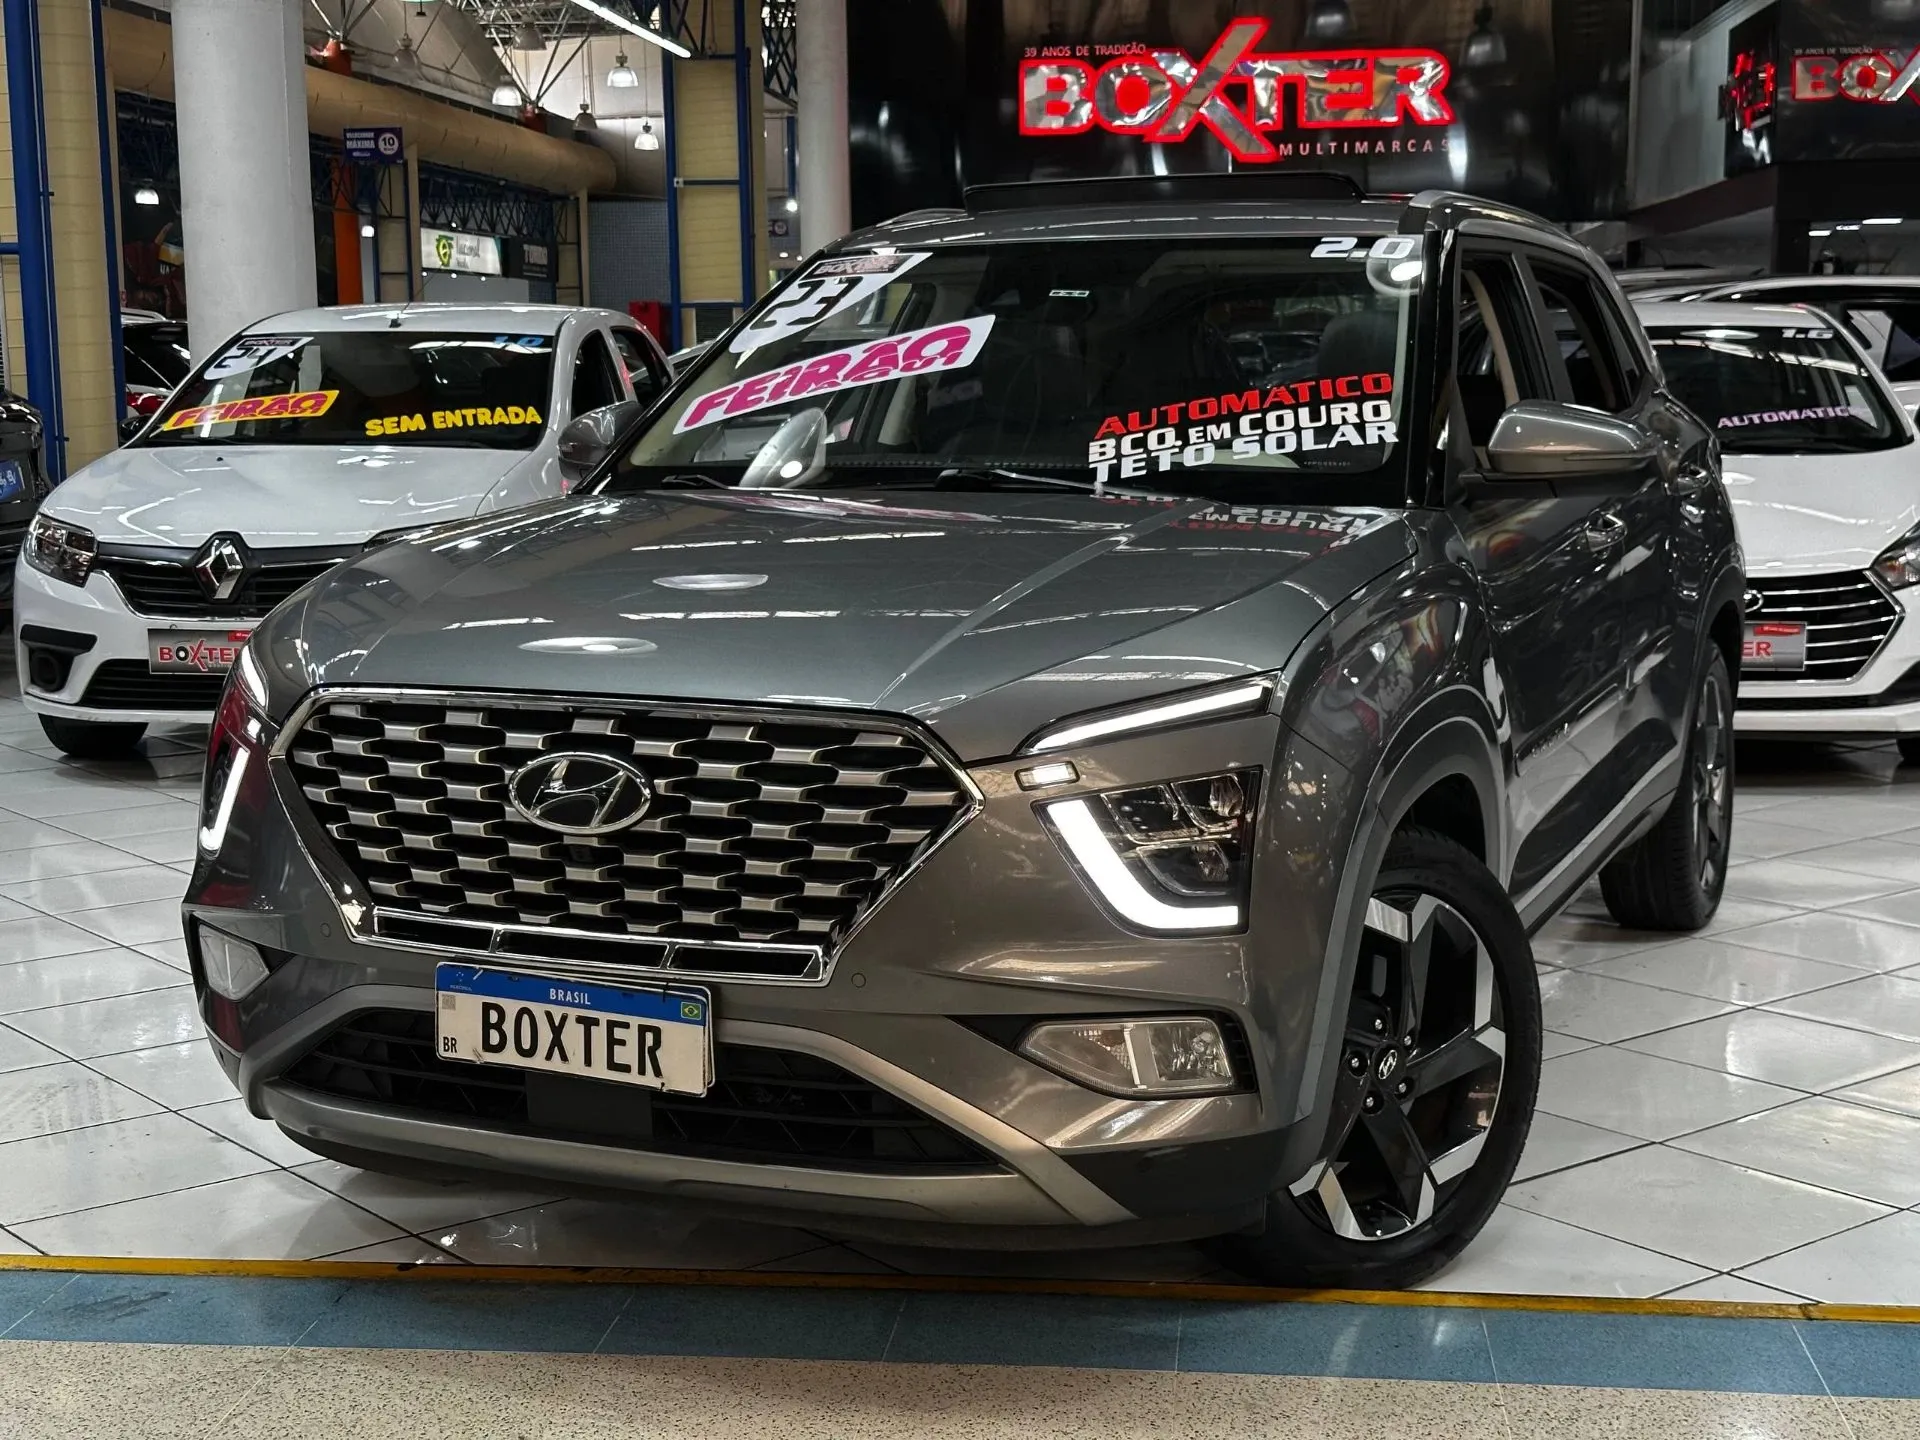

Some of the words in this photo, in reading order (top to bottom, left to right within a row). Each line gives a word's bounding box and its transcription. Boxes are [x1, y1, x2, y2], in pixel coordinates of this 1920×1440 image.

[1024, 47, 1037, 57] 39
[1042, 46, 1071, 57] ANOS
[1076, 45, 1089, 56] DE
[1095, 42, 1146, 55] TRADIÇÃO
[1019, 17, 1456, 163] BOXTER
[382, 136, 396, 147] 10
[1279, 138, 1450, 157] MULTIMARCAS
[1310, 236, 1415, 259] 2.0
[749, 276, 864, 331] 23
[494, 335, 545, 349] 10
[213, 346, 278, 370] 24
[365, 412, 427, 437] SEM
[432, 405, 542, 429] ENTRADA
[1188, 422, 1231, 444] EM
[1239, 400, 1392, 436] COURO
[1088, 442, 1215, 483] TETO
[1232, 421, 1399, 460] SOLAR
[549, 988, 591, 1006] BRASIL
[443, 1036, 458, 1054] BR
[481, 1001, 664, 1079] BOXTER
